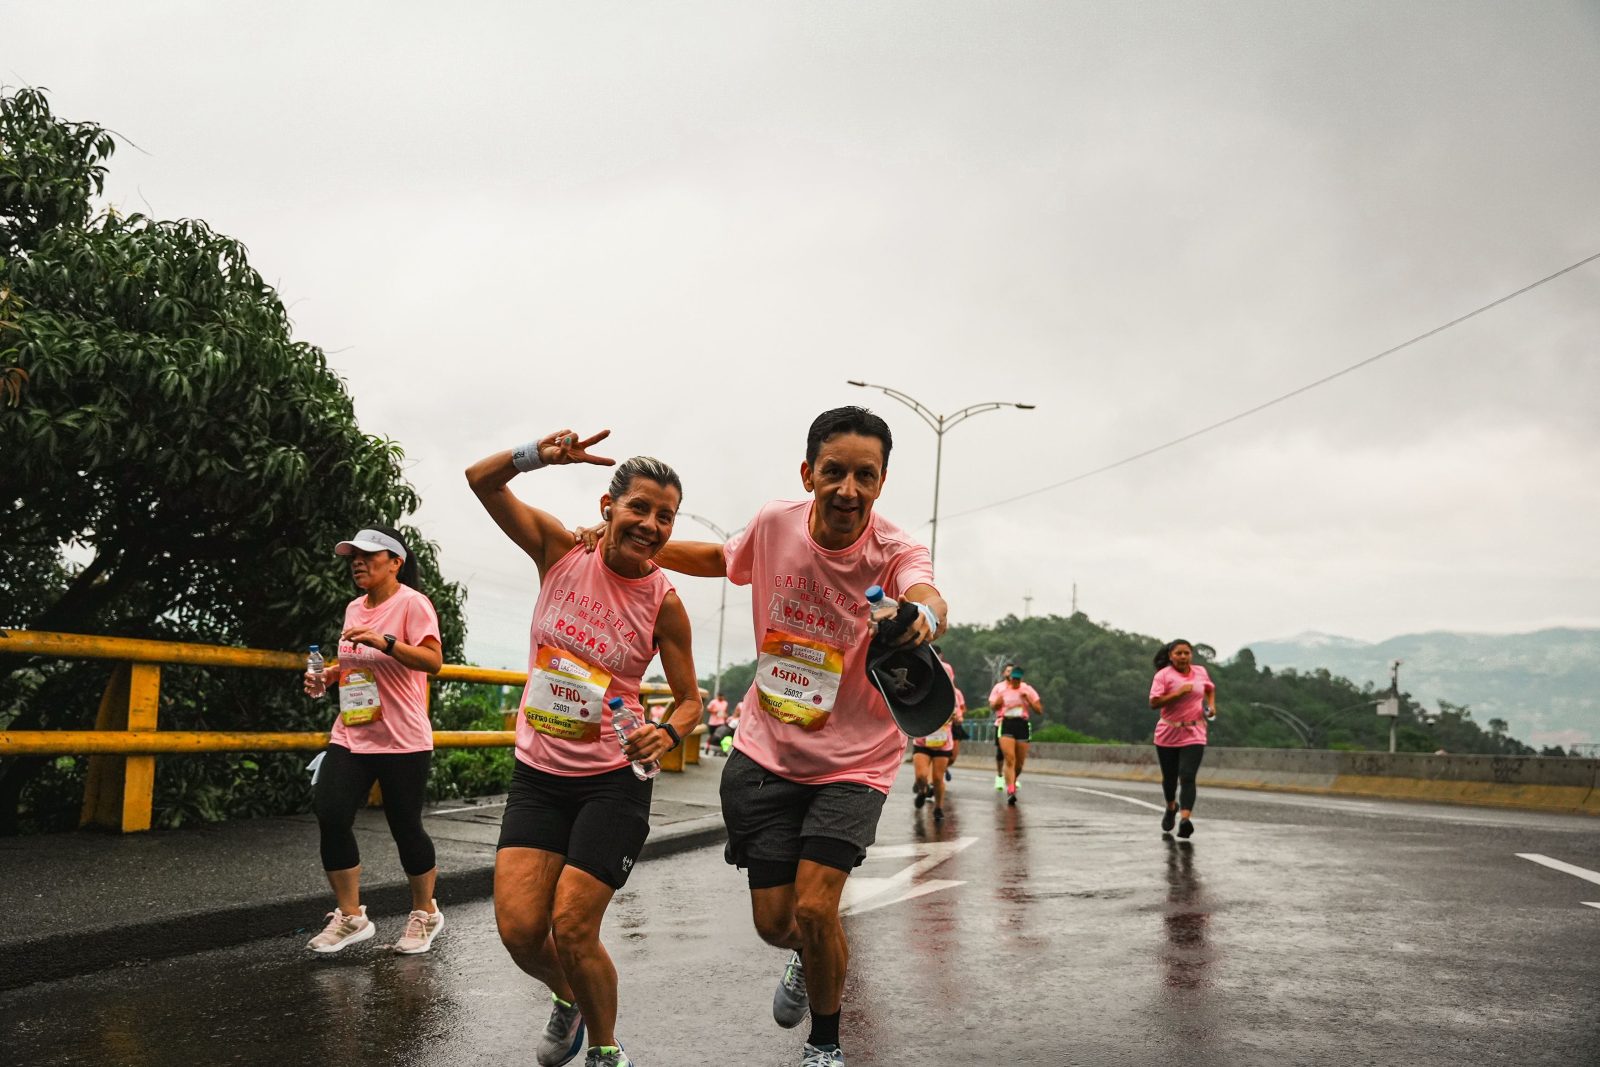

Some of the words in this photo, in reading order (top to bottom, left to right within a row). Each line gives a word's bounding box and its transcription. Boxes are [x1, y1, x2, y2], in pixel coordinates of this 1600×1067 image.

[775, 575, 860, 615] CARRERA
[800, 593, 810, 602] DE
[554, 589, 637, 643] CARRERA
[578, 610, 588, 619] DE
[589, 617, 606, 629] LAS
[768, 592, 857, 646] ALMA
[784, 606, 835, 631] ROSAS
[538, 605, 629, 671] ALMA
[555, 619, 608, 654] ROSAS
[550, 683, 581, 703] VERO
[783, 687, 803, 699] 25033
[553, 702, 570, 714] 25031
